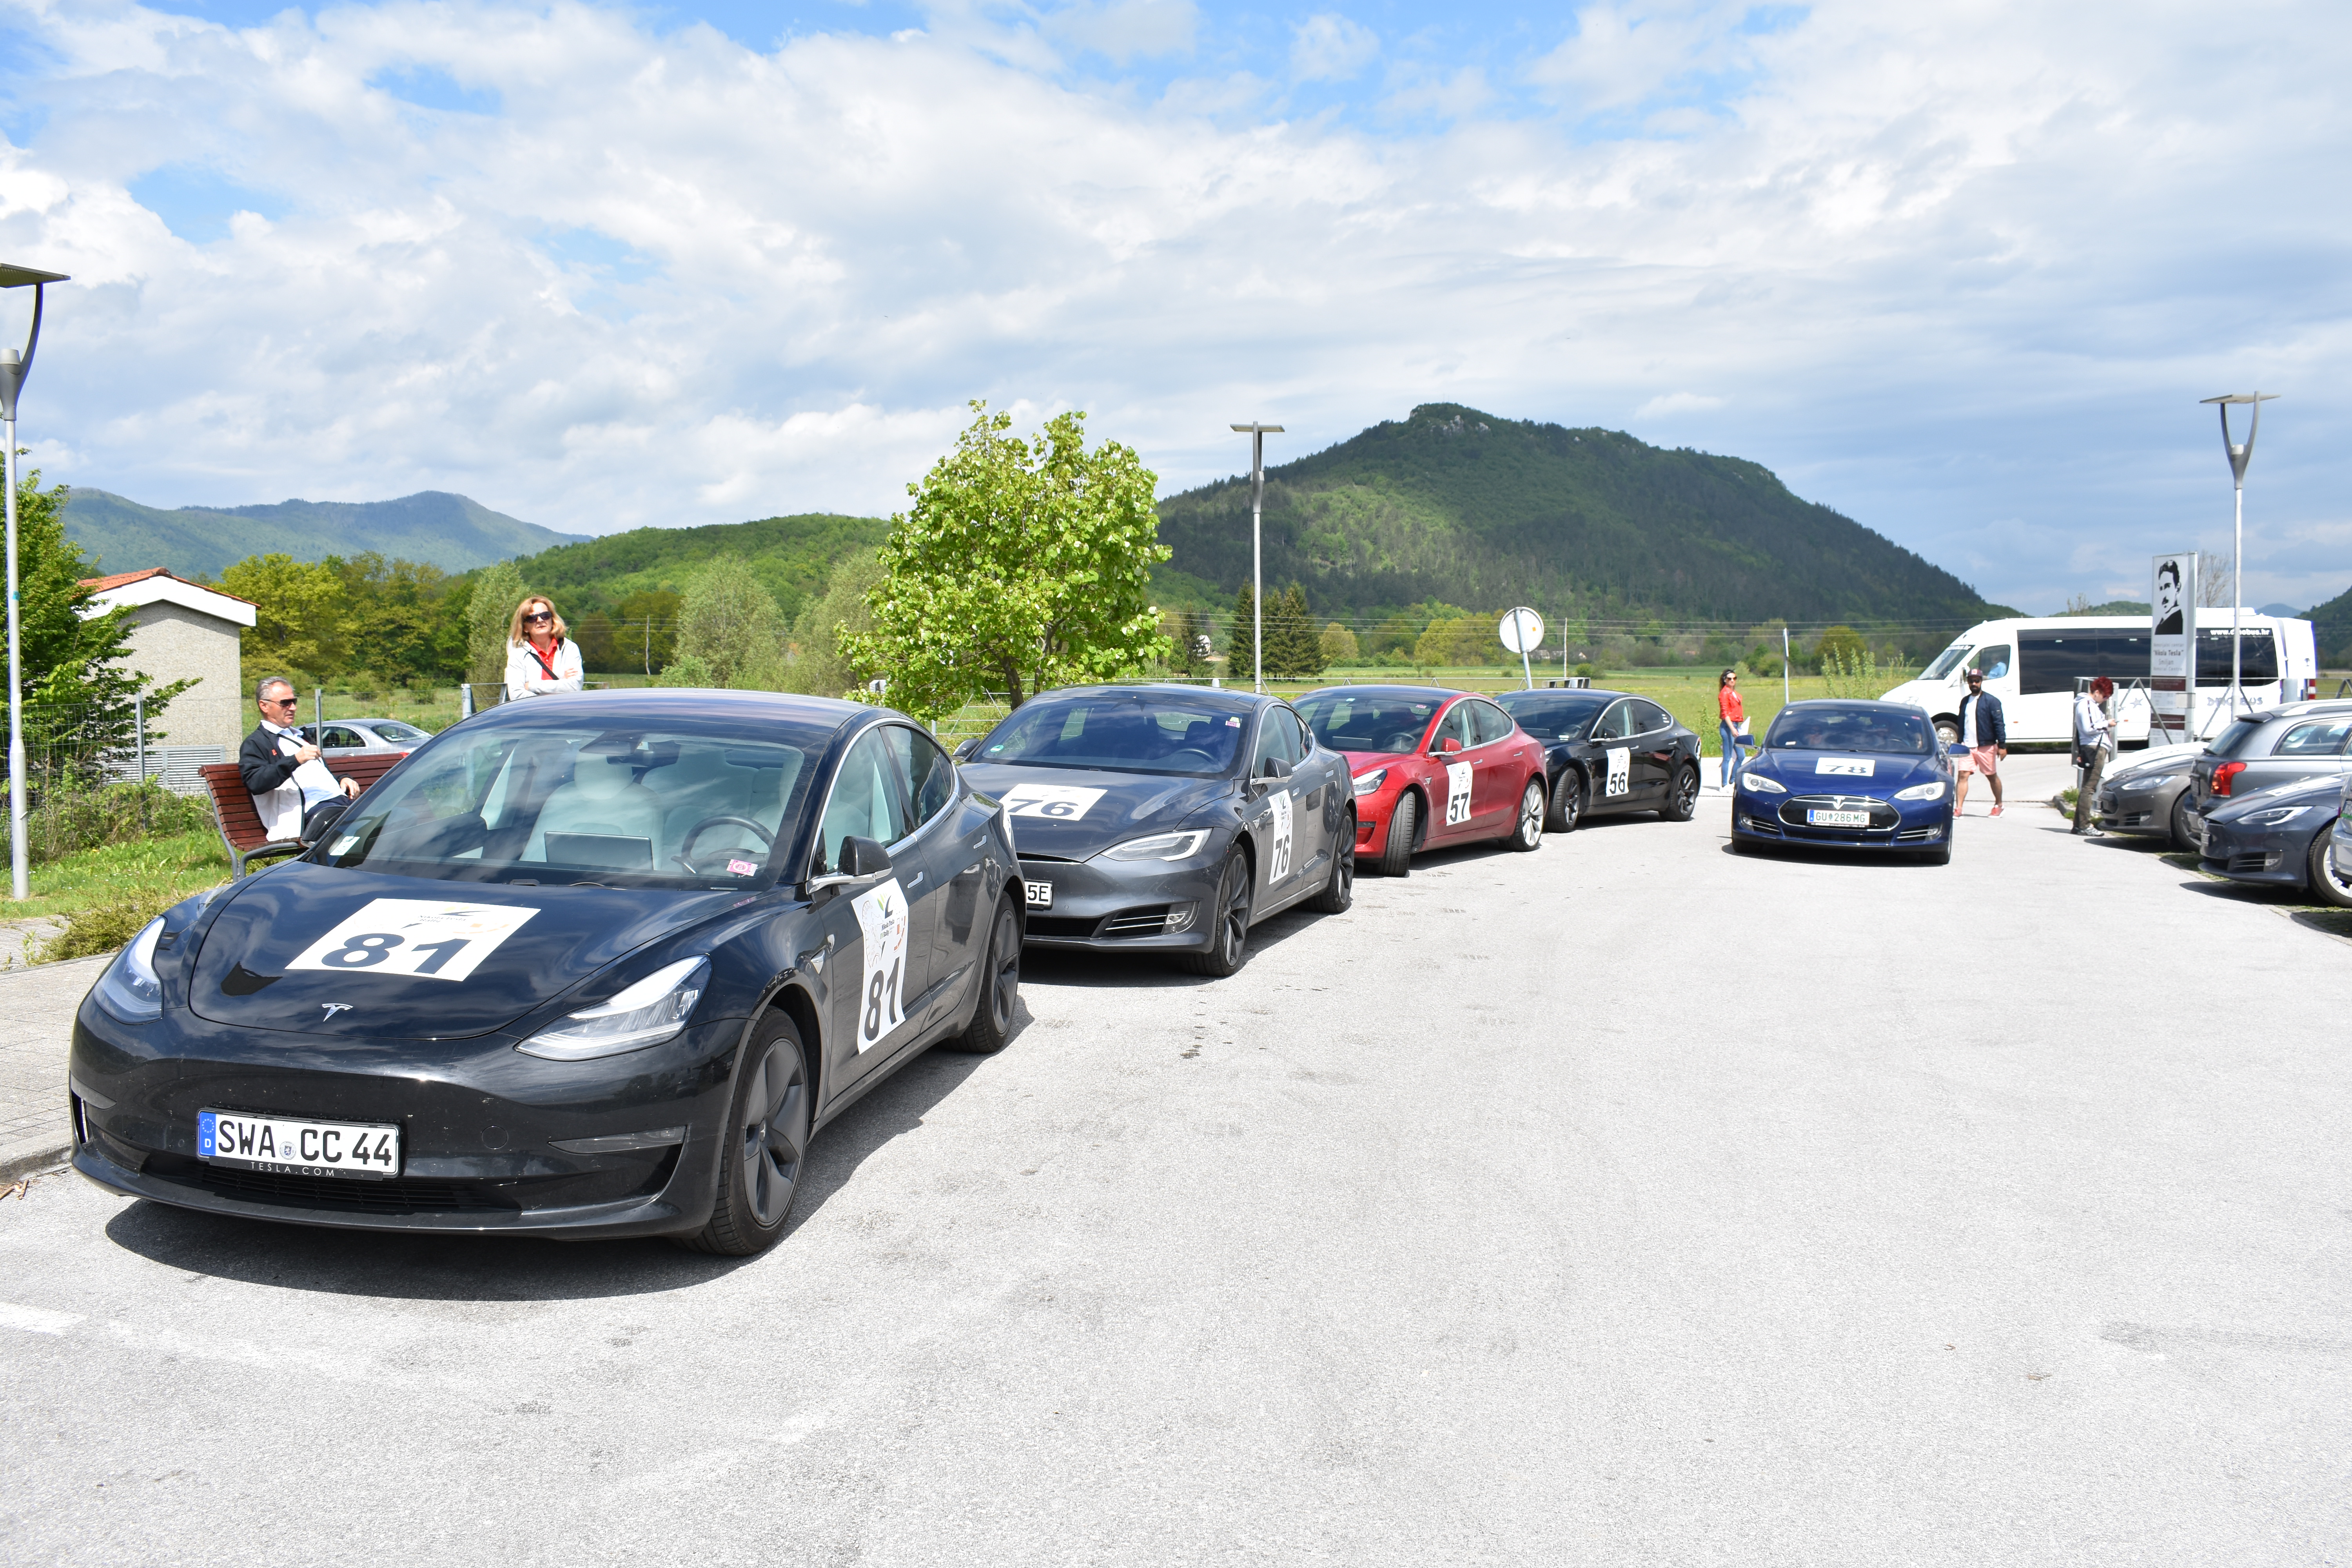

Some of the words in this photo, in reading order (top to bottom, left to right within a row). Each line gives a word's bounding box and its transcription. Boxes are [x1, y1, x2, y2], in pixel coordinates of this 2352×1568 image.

[1826, 765, 1866, 773] 78
[1609, 772, 1625, 794] 56
[1008, 798, 1079, 817] 76
[1450, 792, 1469, 822] 57
[1816, 812, 1827, 821] GU
[1273, 834, 1289, 879] 76
[321, 933, 472, 975] 81
[864, 956, 900, 1041] 81
[204, 1138, 211, 1148] D
[218, 1120, 276, 1158] SWA
[300, 1129, 342, 1163] CC
[352, 1132, 392, 1166] 44
[250, 1161, 334, 1176] TESLA.COM
